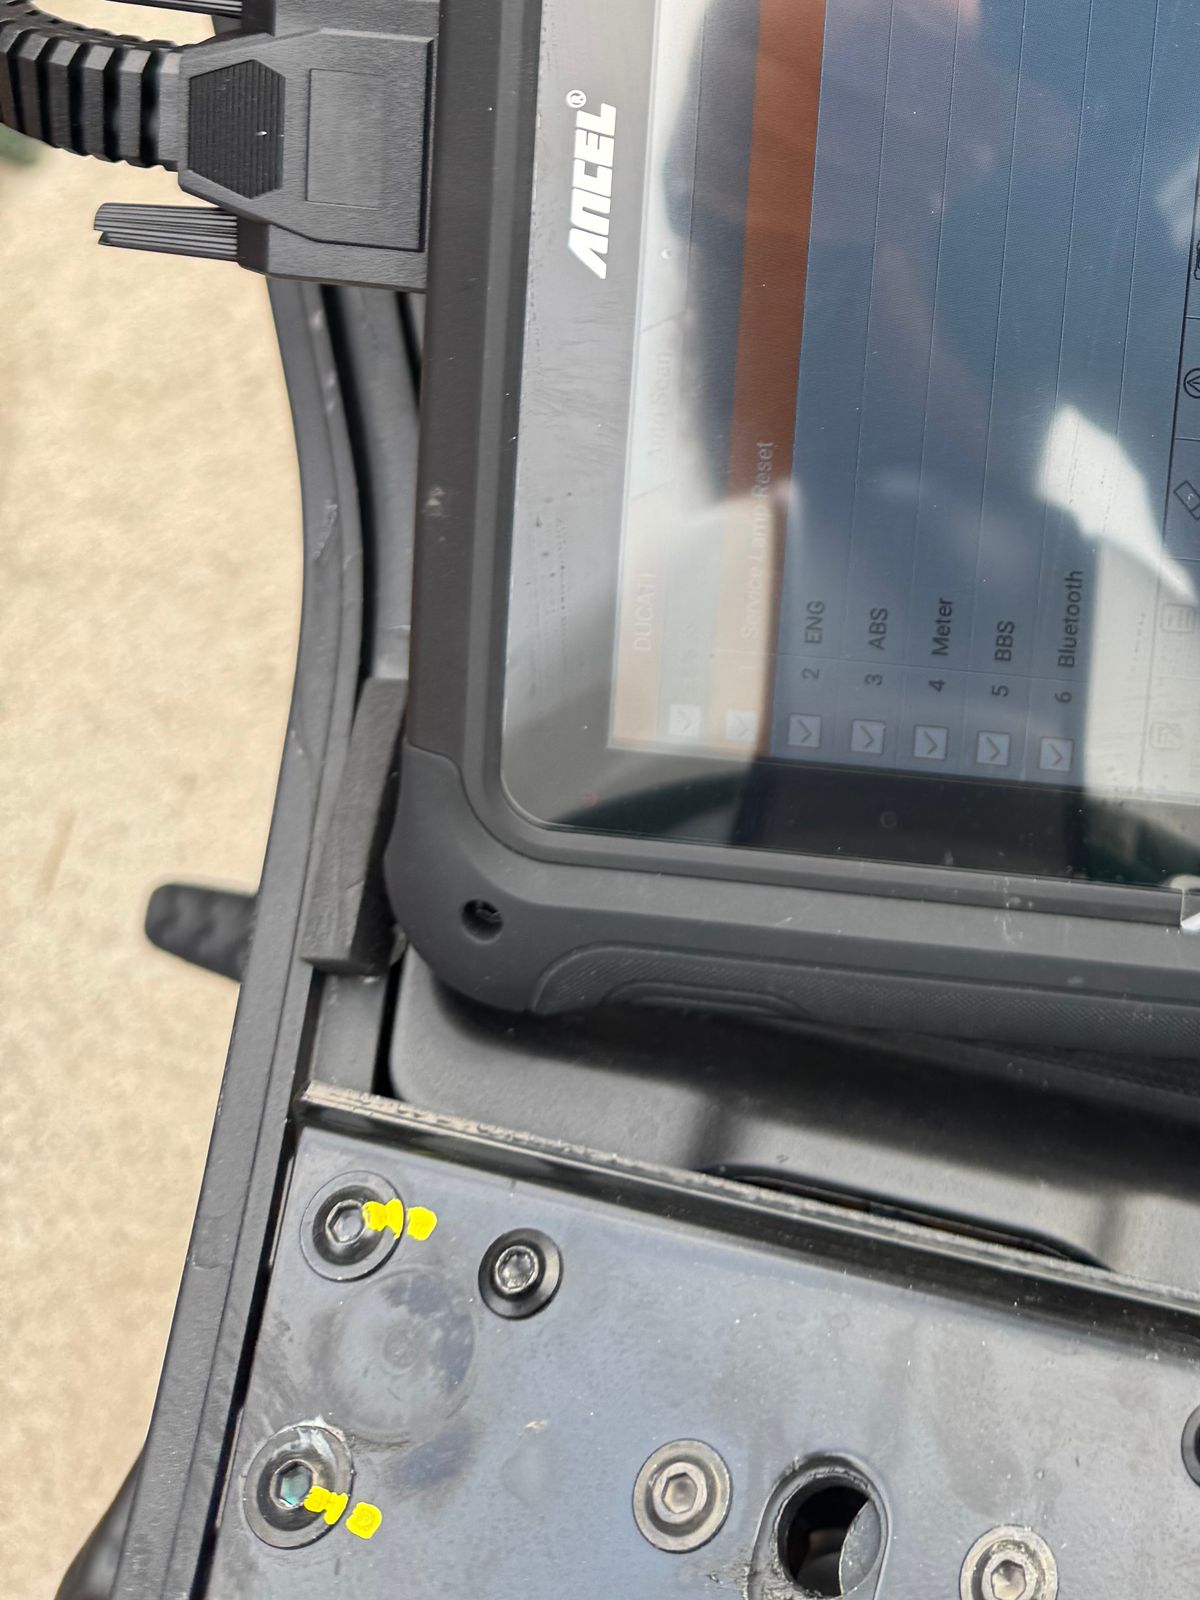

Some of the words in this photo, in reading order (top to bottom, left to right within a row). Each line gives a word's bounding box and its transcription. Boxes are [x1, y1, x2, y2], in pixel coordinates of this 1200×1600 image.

[652, 349, 674, 406] Scan
[751, 439, 776, 498] Reset
[747, 504, 772, 562] Lamp
[741, 566, 765, 639] Service
[804, 599, 825, 644] ENG
[1056, 569, 1084, 668] Bluetooth
[869, 606, 888, 650] ABS
[930, 596, 953, 655] Meter
[993, 619, 1015, 662] BBS
[802, 667, 819, 679] 2
[865, 673, 883, 686] 3
[928, 678, 946, 692] 4
[991, 683, 1009, 697] 5
[1054, 690, 1073, 704] 6
